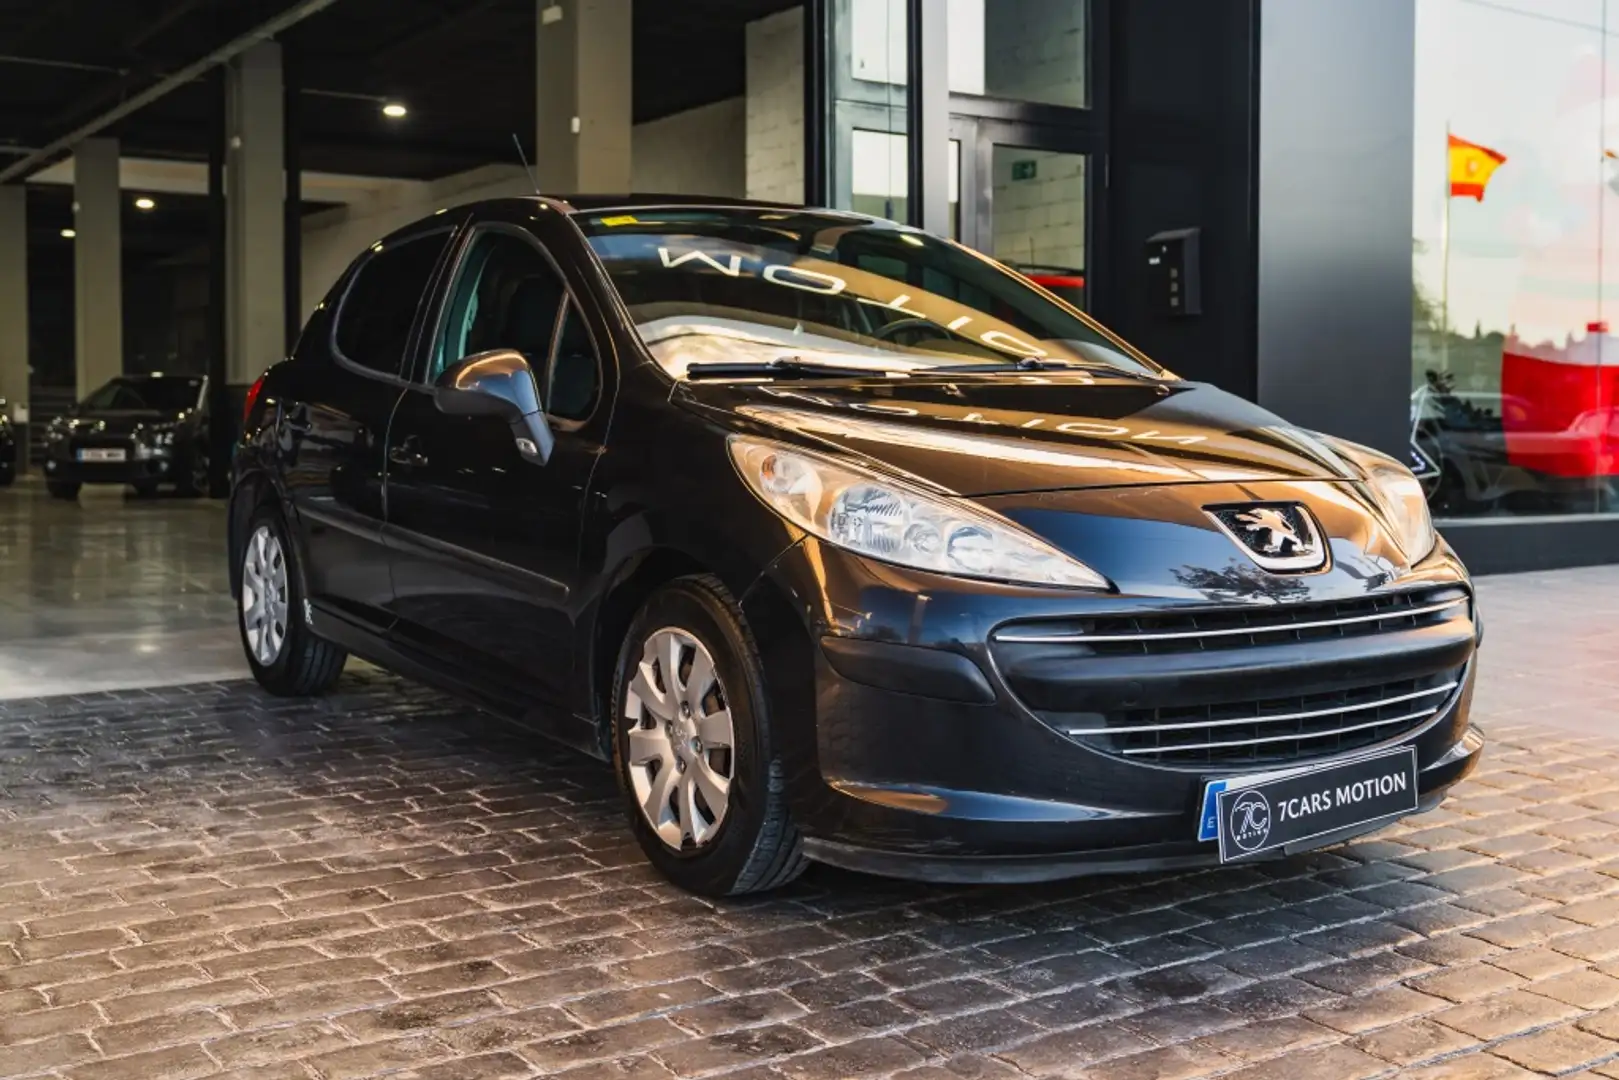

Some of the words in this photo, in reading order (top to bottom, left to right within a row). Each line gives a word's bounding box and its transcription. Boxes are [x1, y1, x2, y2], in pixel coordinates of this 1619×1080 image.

[1278, 790, 1332, 822] 7CARS
[1336, 771, 1406, 807] MOTION
[1206, 816, 1216, 829] E
